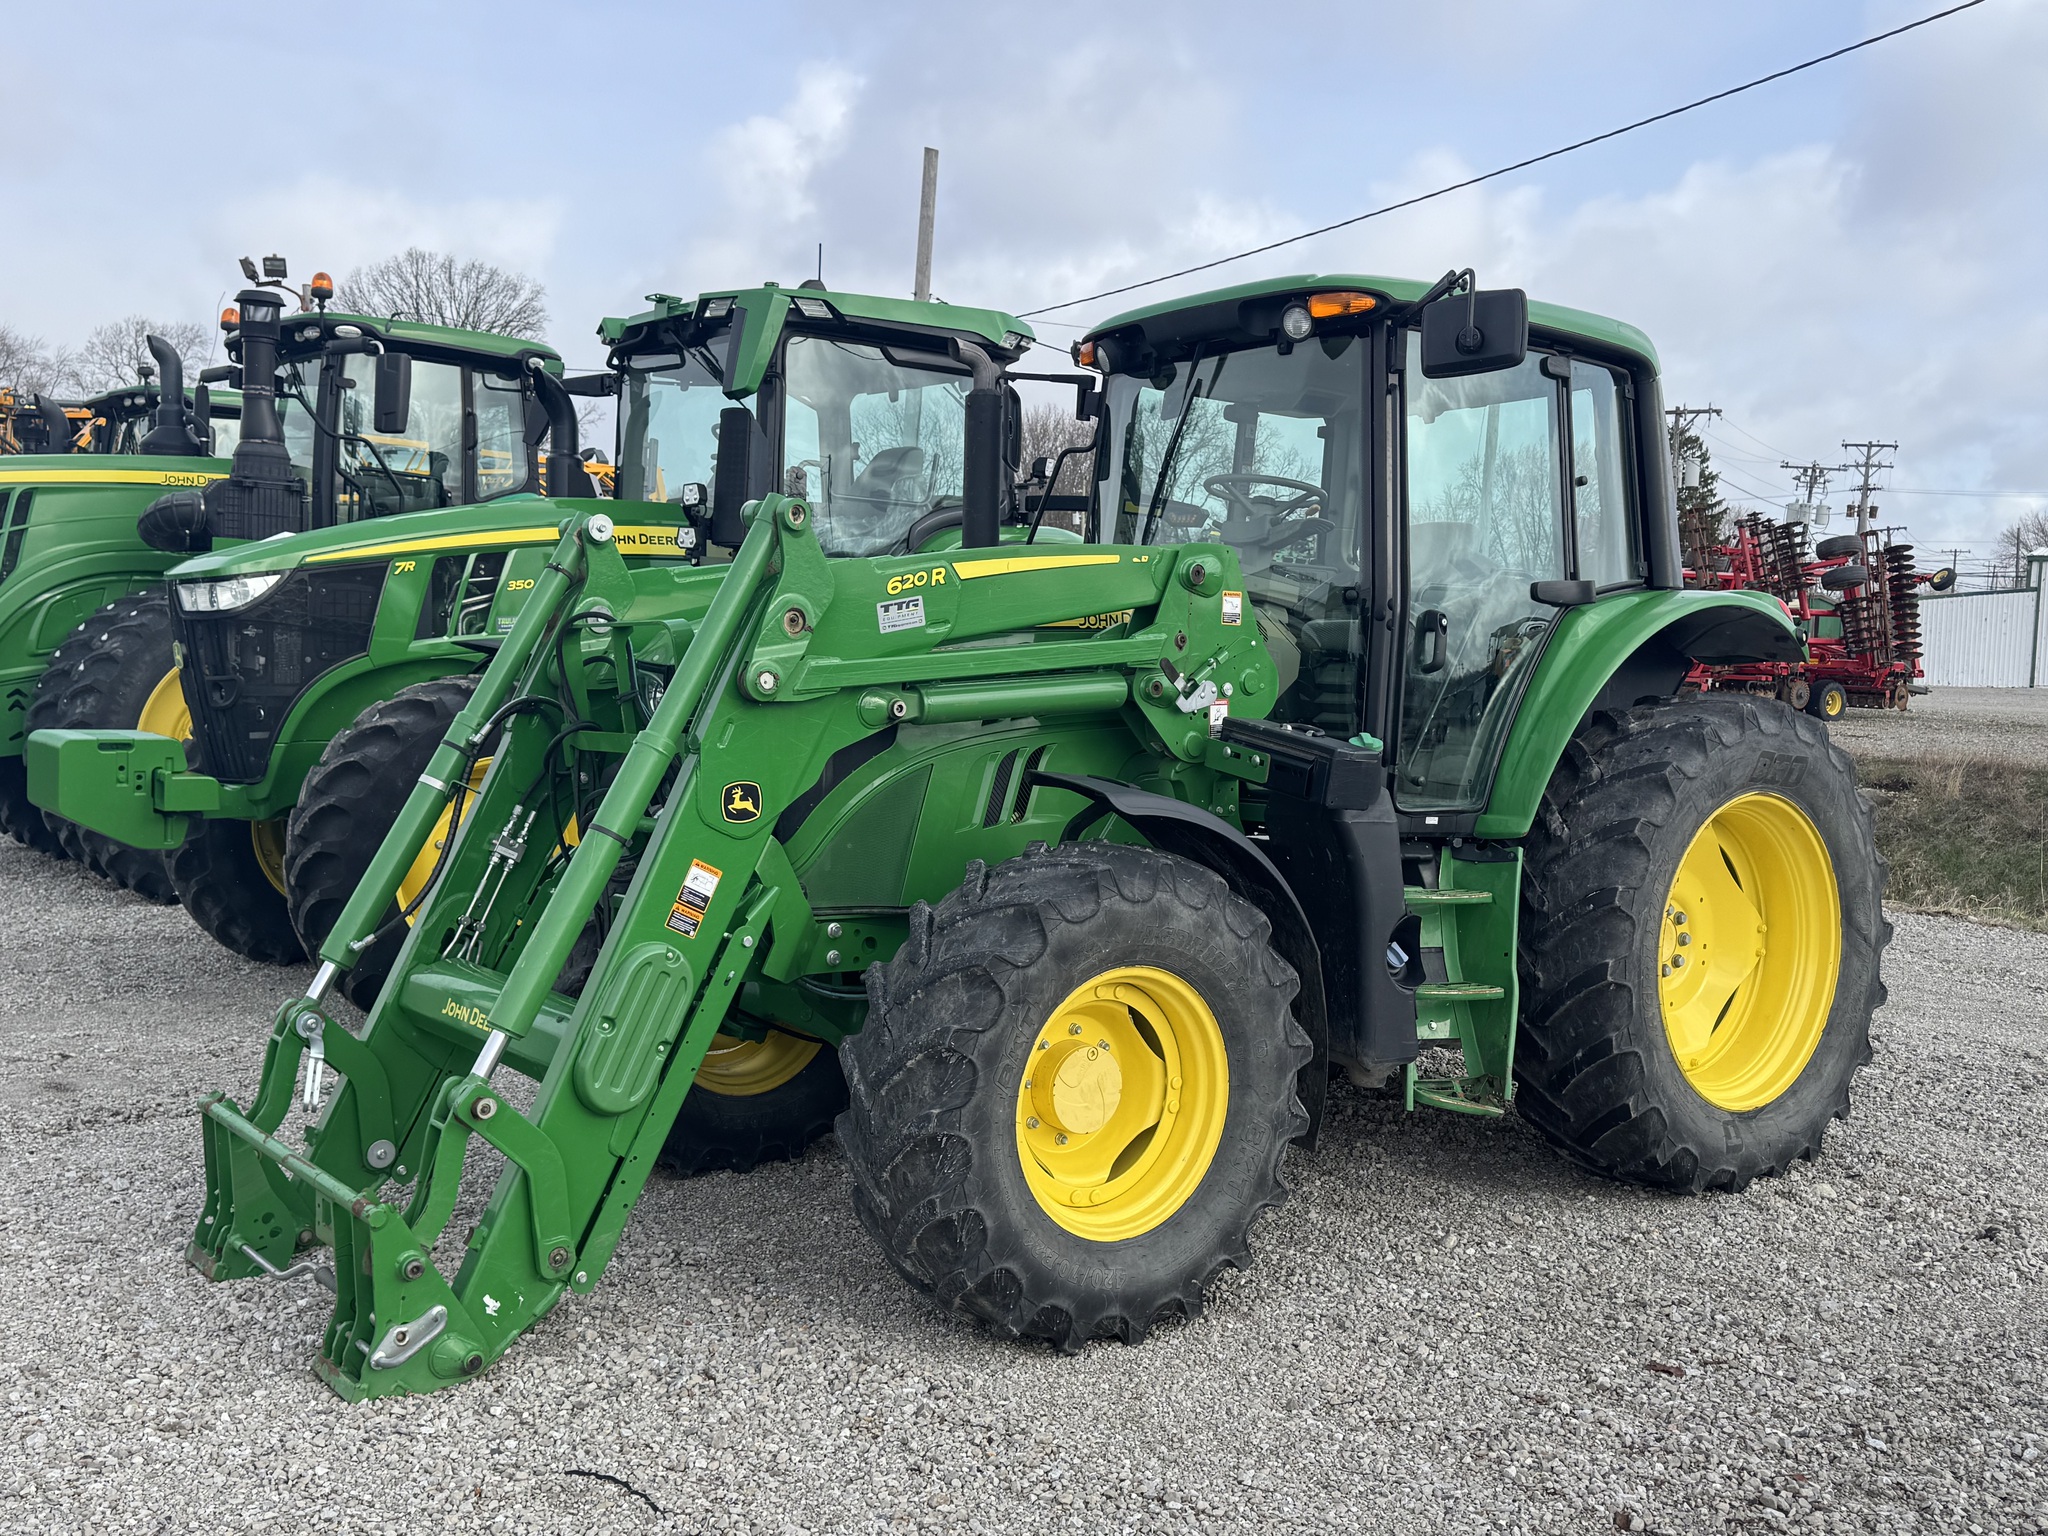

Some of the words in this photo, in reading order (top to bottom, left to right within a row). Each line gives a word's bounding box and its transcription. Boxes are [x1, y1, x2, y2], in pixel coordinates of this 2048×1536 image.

[161, 474, 194, 485] JOHN
[394, 561, 416, 575] 7R
[506, 578, 535, 592] 350
[887, 570, 928, 596] 620
[880, 598, 920, 615] TTG
[441, 997, 470, 1023] JOHN
[1225, 1119, 1268, 1203] BKT
